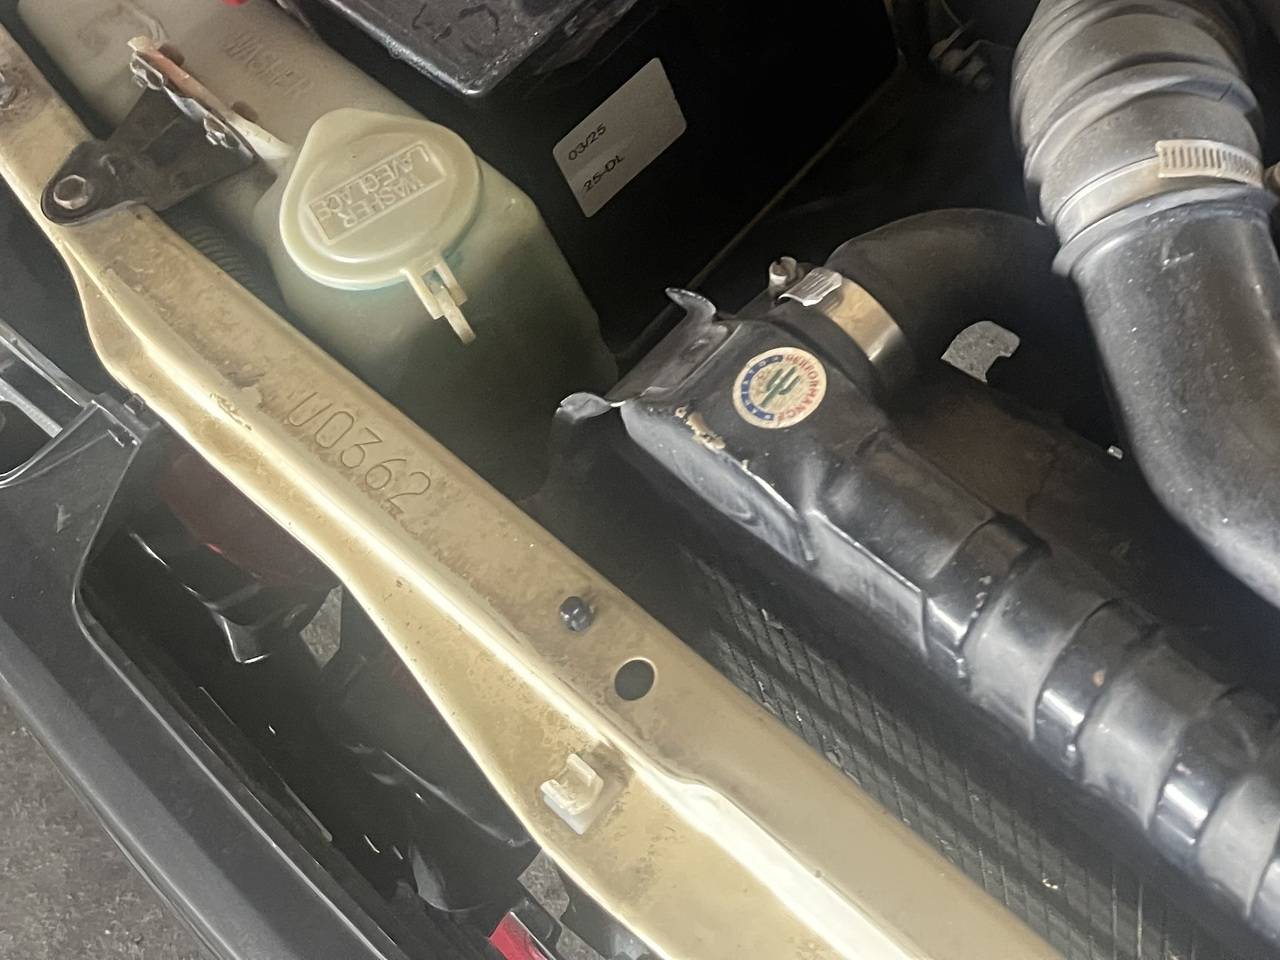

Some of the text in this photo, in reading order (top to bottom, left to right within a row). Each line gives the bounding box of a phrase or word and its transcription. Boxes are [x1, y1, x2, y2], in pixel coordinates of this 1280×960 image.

[567, 122, 608, 161] 03/25
[336, 173, 427, 228] WASHER
[288, 391, 432, 515] U0362
